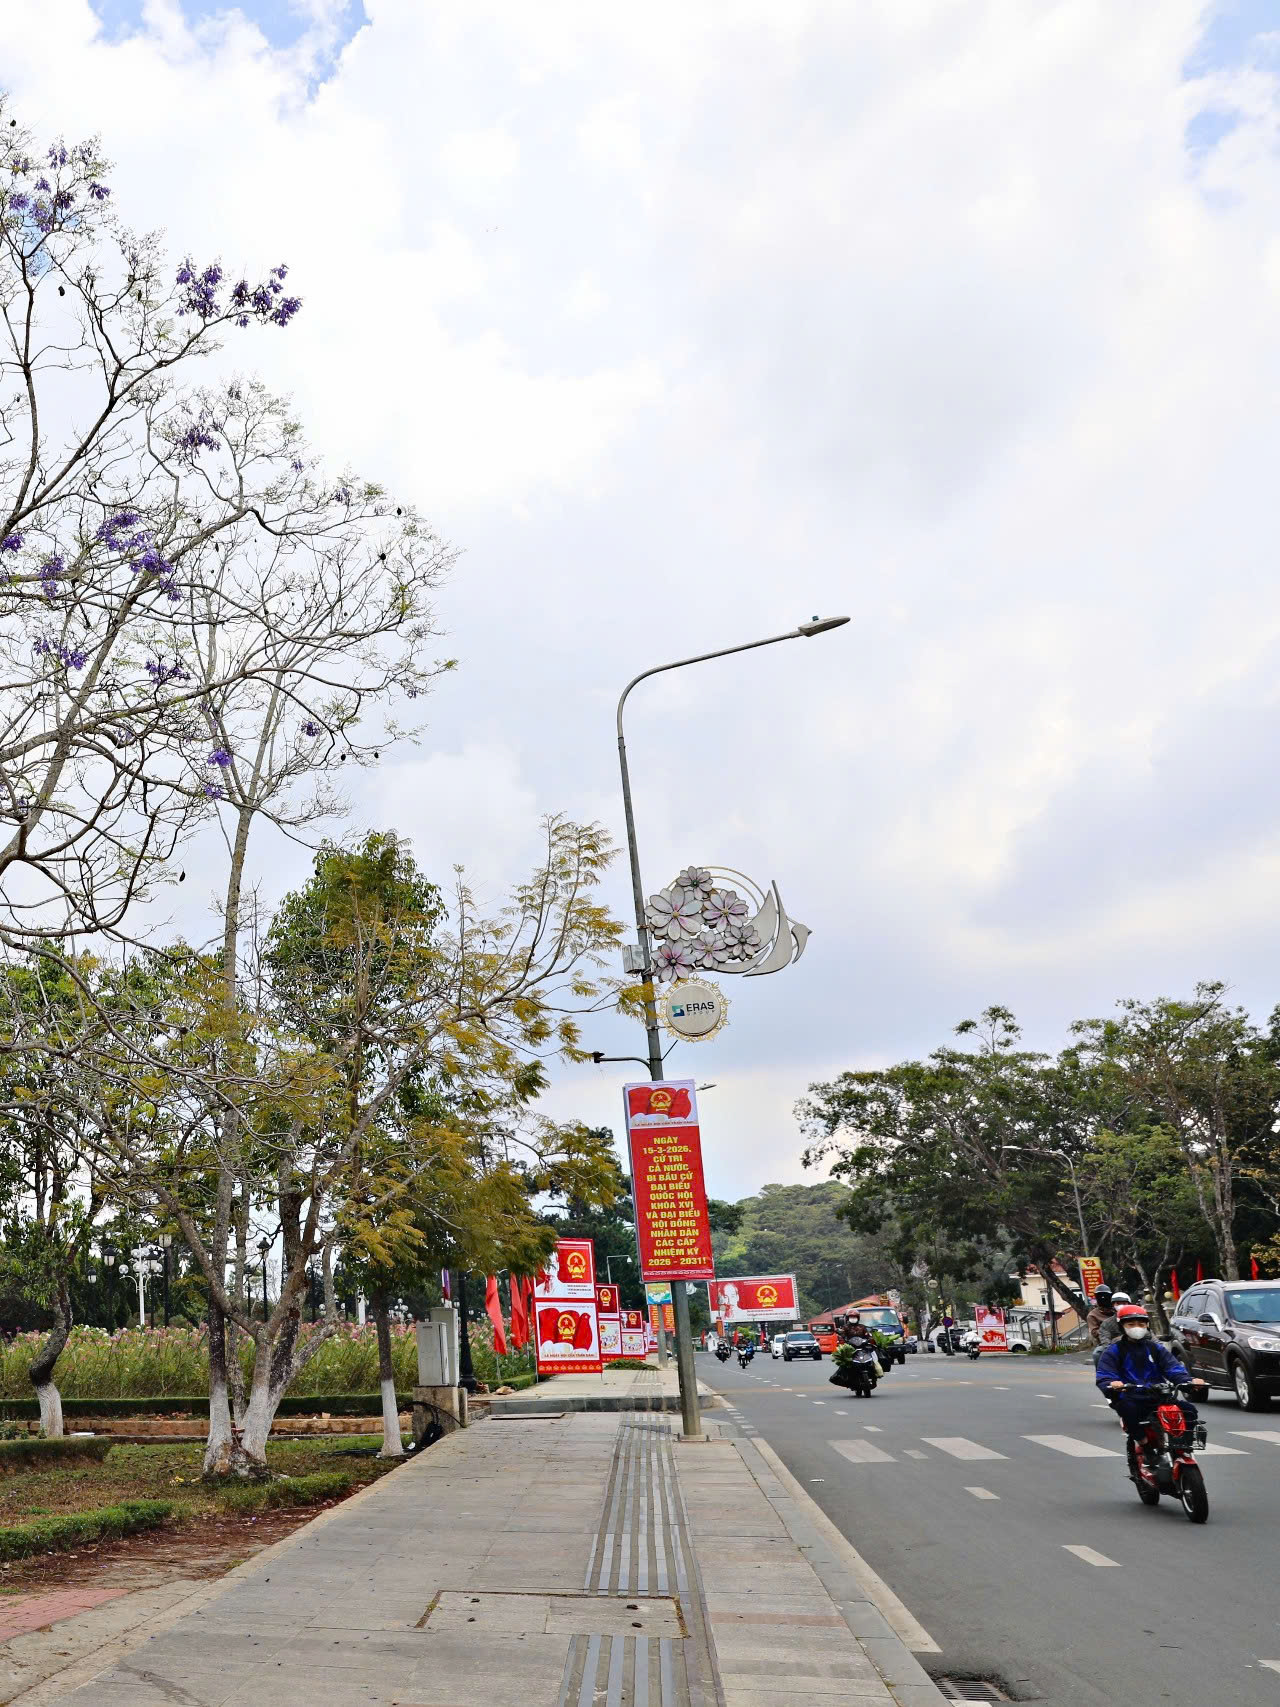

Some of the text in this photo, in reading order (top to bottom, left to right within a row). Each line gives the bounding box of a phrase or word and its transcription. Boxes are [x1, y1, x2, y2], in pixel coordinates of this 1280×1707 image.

[686, 1001, 715, 1012] ERAS
[653, 1136, 678, 1145] NGÀY
[642, 1145, 692, 1154] 15-3-2026.
[653, 1153, 683, 1163] CỬ TRI
[648, 1163, 690, 1172] CẢ NƯỚC
[646, 1174, 657, 1182] ĐI
[650, 1180, 690, 1192] ĐẠI BIỂU
[649, 1191, 693, 1200] QUỐC HỘI
[650, 1201, 676, 1209] KHÓA
[646, 1208, 700, 1219] VÀ ĐẠI BIỂU
[651, 1220, 668, 1229] HỘI
[650, 1228, 699, 1238] NHÂN DÂN
[655, 1237, 696, 1247] CÁC CẤP
[653, 1248, 685, 1257] NHIỆM
[648, 1258, 671, 1266] 2026
[680, 1256, 707, 1265] 2031!
